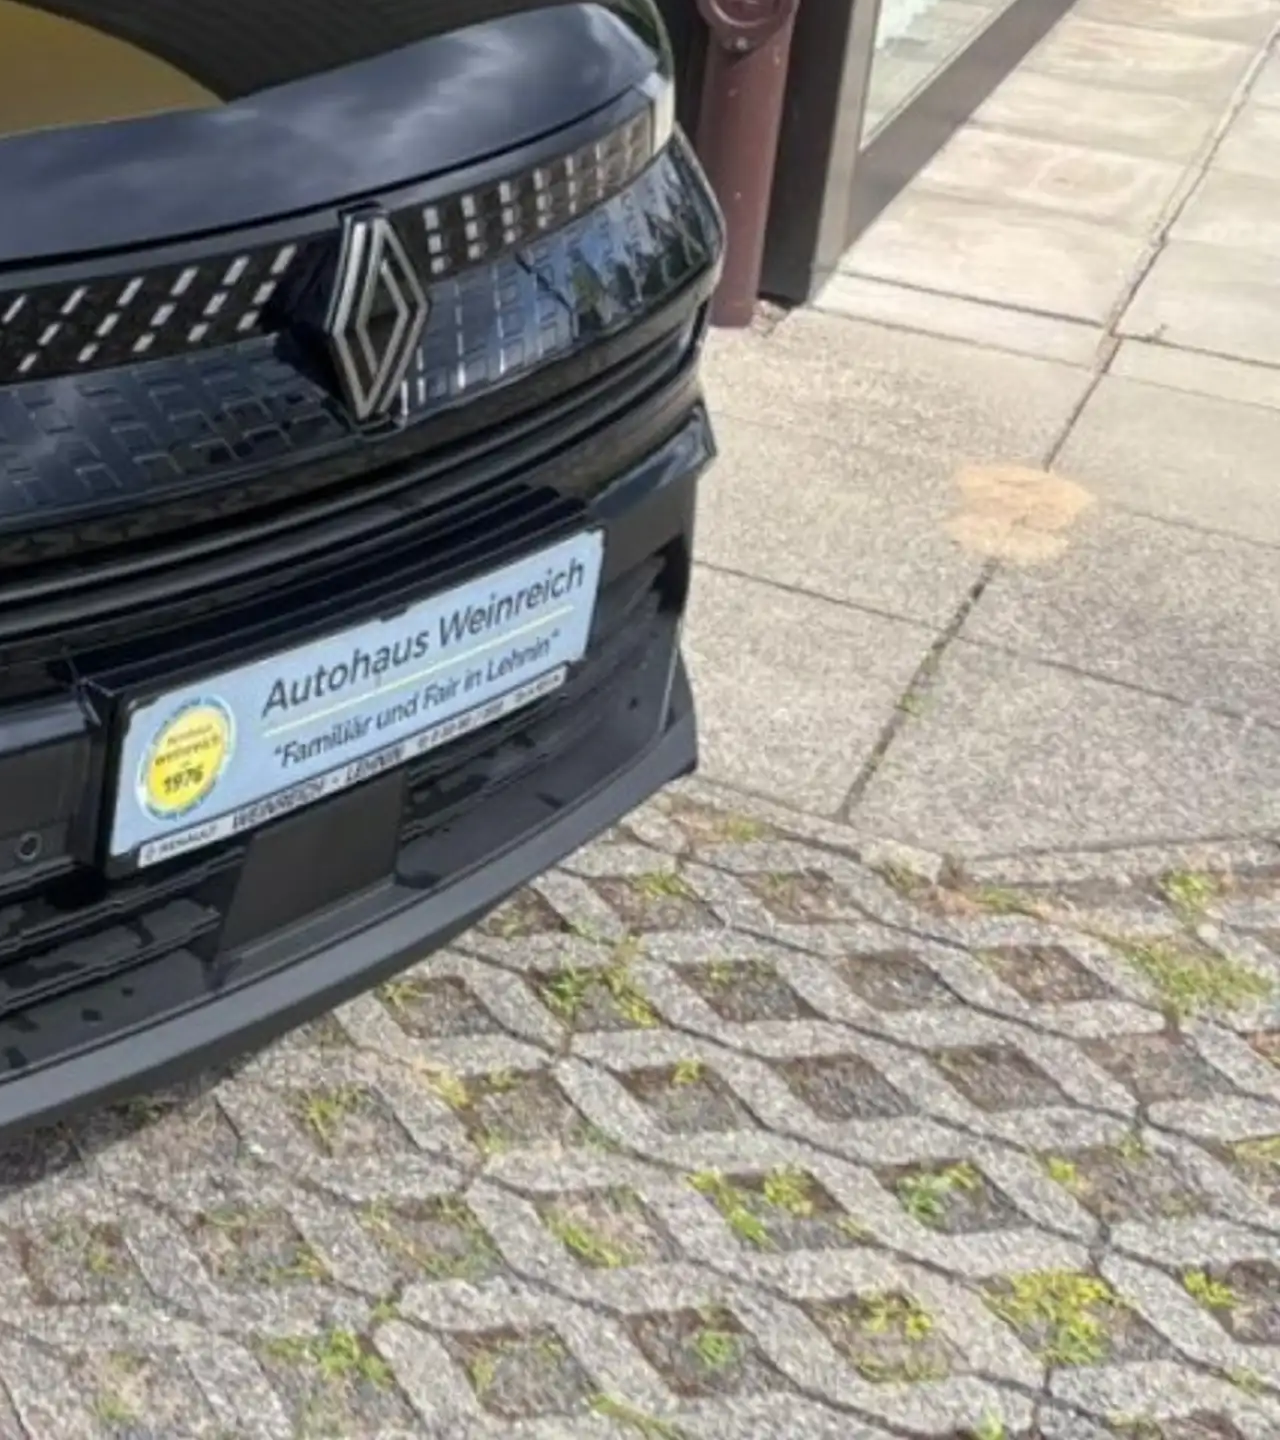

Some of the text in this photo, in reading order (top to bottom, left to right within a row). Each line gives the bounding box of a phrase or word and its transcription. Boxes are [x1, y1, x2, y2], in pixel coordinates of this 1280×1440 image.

[260, 557, 585, 719] Autohaus Weinreich
[375, 692, 420, 731] und
[422, 676, 462, 711] Fair
[463, 668, 482, 693] in
